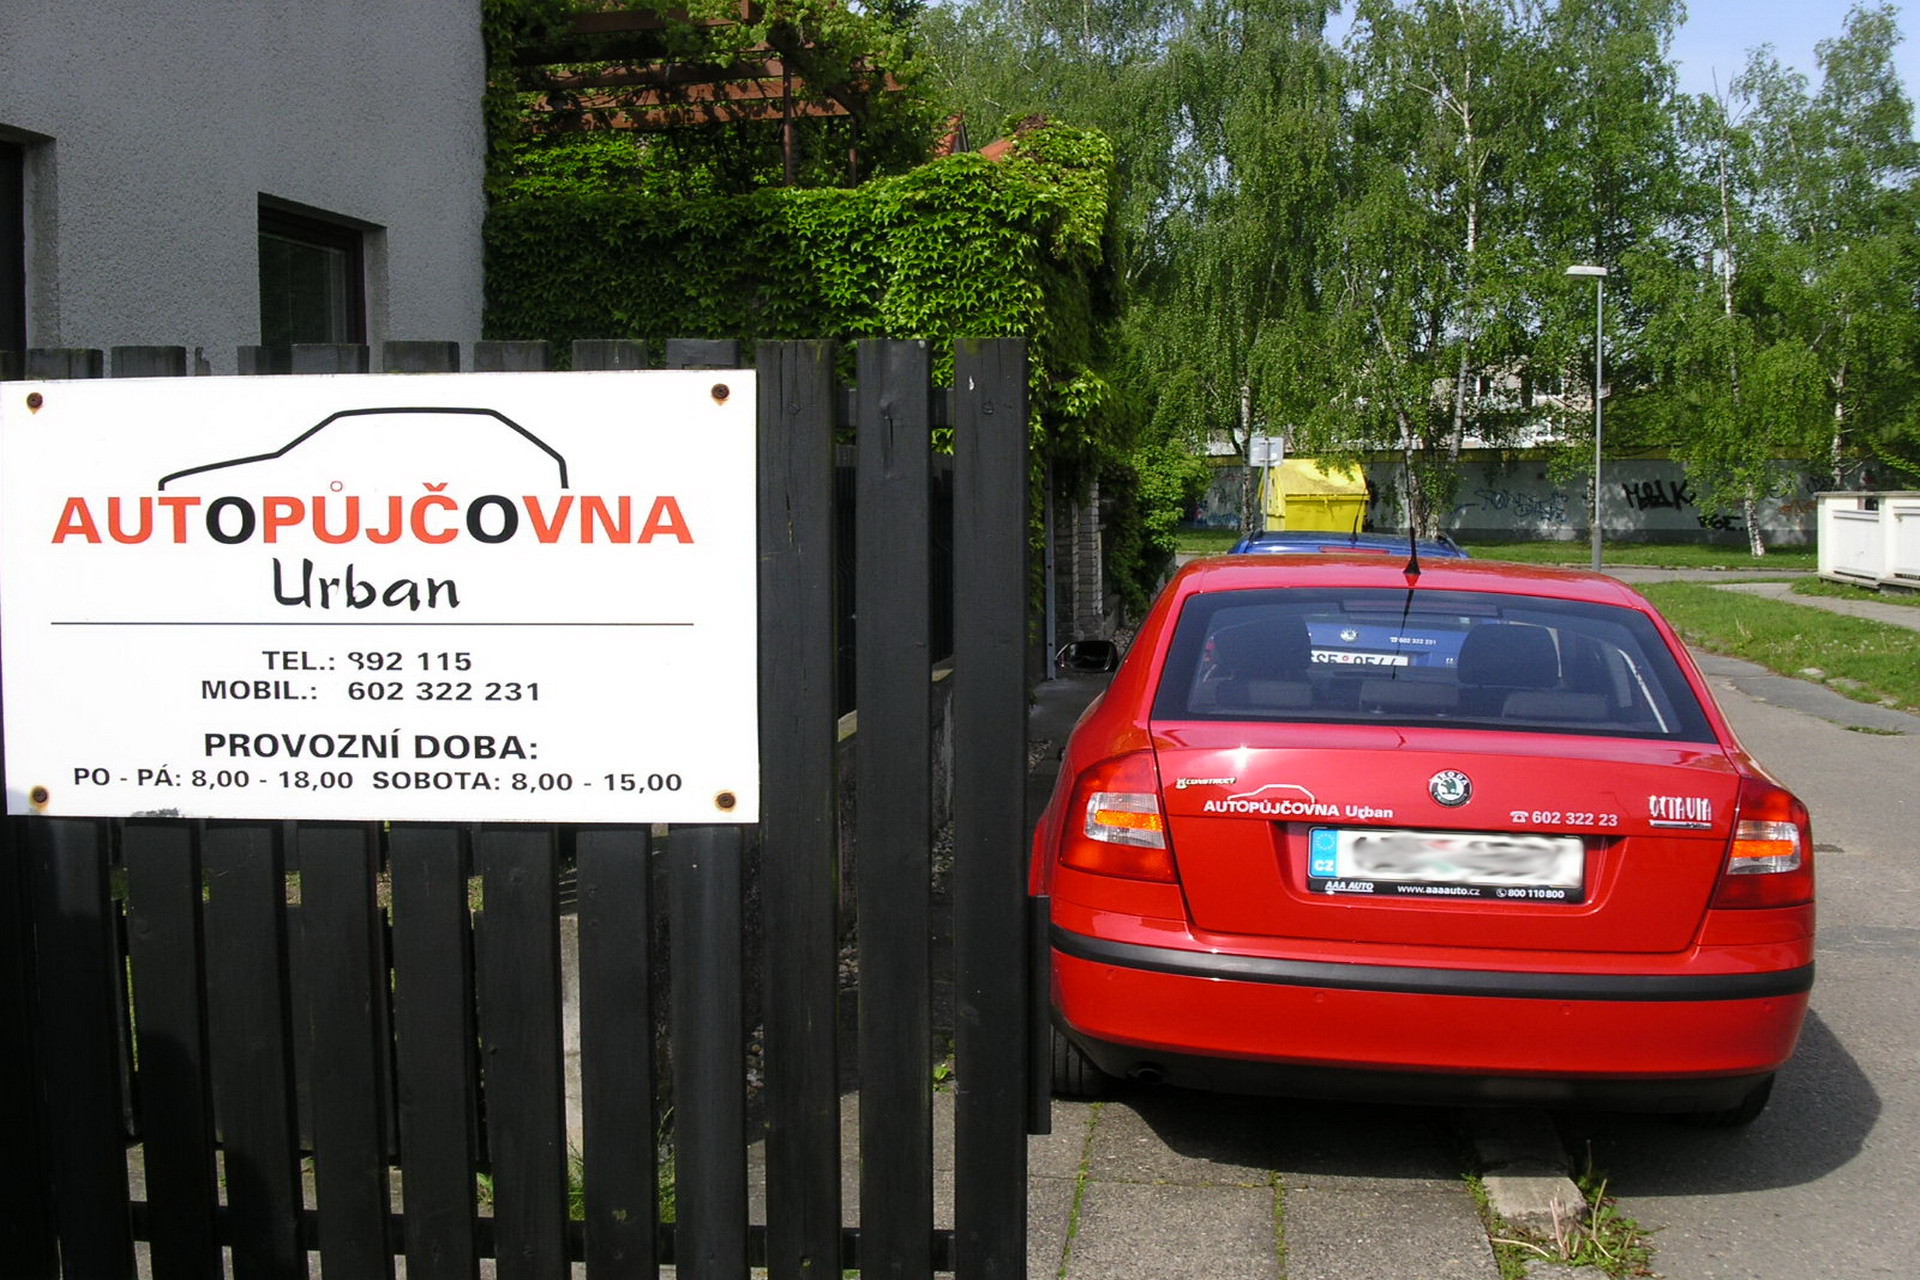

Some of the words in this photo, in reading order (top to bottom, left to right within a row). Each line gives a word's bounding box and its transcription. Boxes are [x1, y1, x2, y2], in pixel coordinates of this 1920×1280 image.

[51, 481, 694, 544] AUTOPŮJČOVNA
[272, 557, 460, 612] Urban
[262, 650, 336, 671] TEL.:
[418, 652, 472, 671] 115
[201, 680, 317, 700] MOBIL.:
[348, 682, 404, 701] 602
[416, 682, 473, 701] 322
[485, 682, 540, 701] 231
[204, 728, 400, 759] PROVOZNÍ
[414, 734, 538, 760] DOBA:
[74, 767, 110, 787] PO
[137, 764, 182, 787] PÁ:
[191, 769, 250, 790] 8,00
[279, 770, 353, 791] 18,00
[372, 771, 501, 791] SOBOTA:
[511, 772, 573, 794] 8,00
[604, 773, 682, 794] 15,00
[1345, 805, 1394, 819] Urban
[1531, 810, 1561, 825] 602
[1565, 811, 1595, 826] 322
[1313, 859, 1335, 872] CZ
[1324, 880, 1346, 891] AAA
[1347, 881, 1375, 891] AUTO
[1507, 888, 1527, 898] 800
[1527, 889, 1546, 898] 110
[1546, 889, 1566, 899] 800
